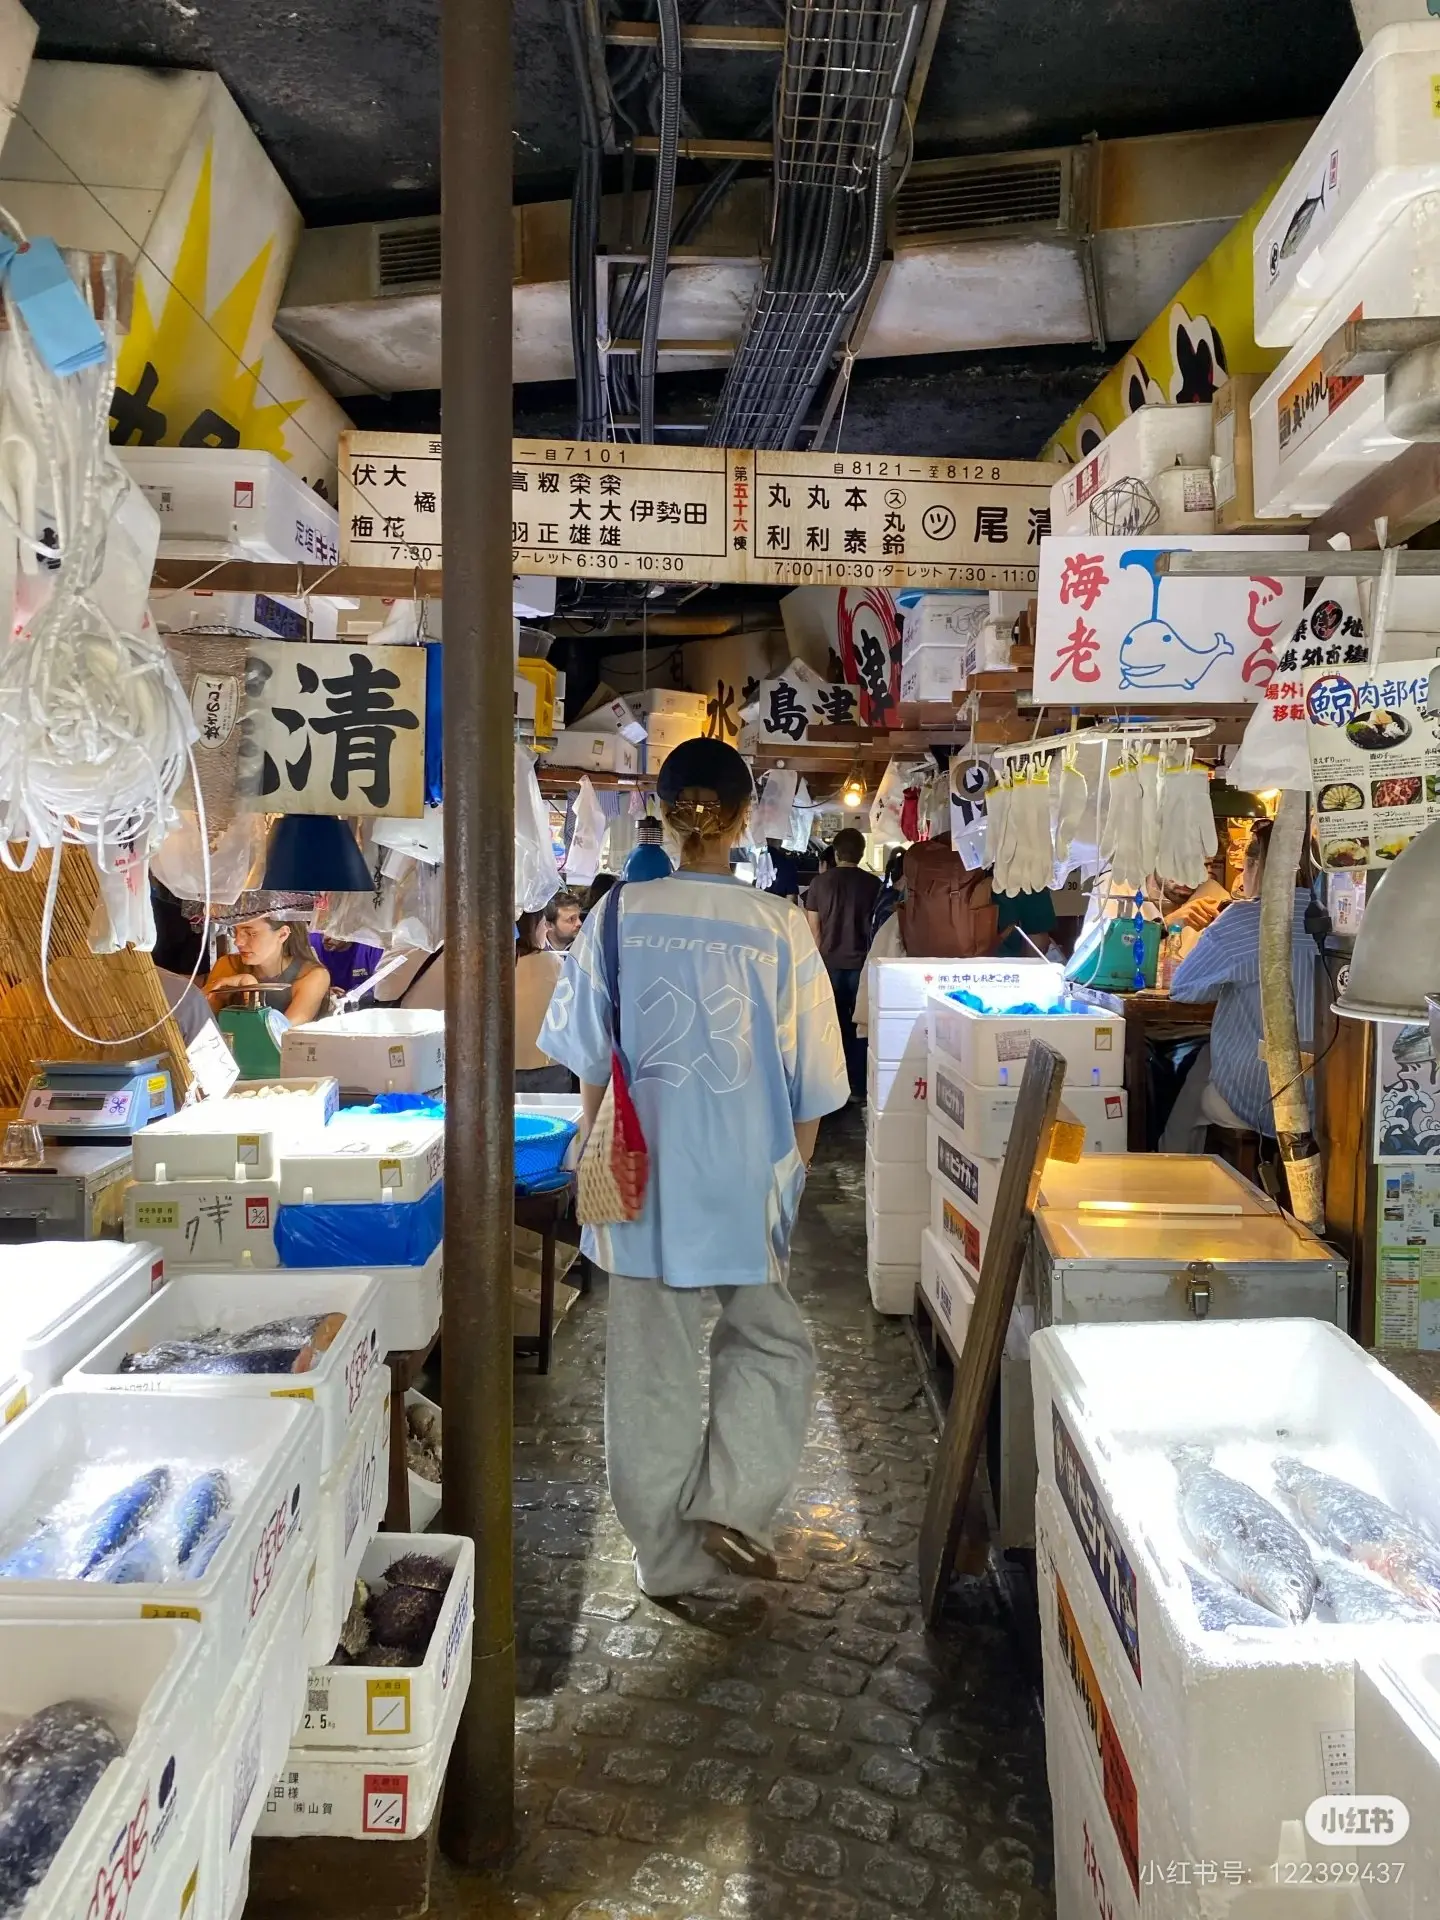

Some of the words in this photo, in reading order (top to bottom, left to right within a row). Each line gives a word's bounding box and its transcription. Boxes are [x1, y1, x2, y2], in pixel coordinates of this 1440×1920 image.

[1050, 552, 1110, 685] 海老
[272, 652, 420, 809] 清
[763, 682, 859, 741] 島津
[1264, 682, 1305, 700] 場外
[632, 976, 759, 1094] 23
